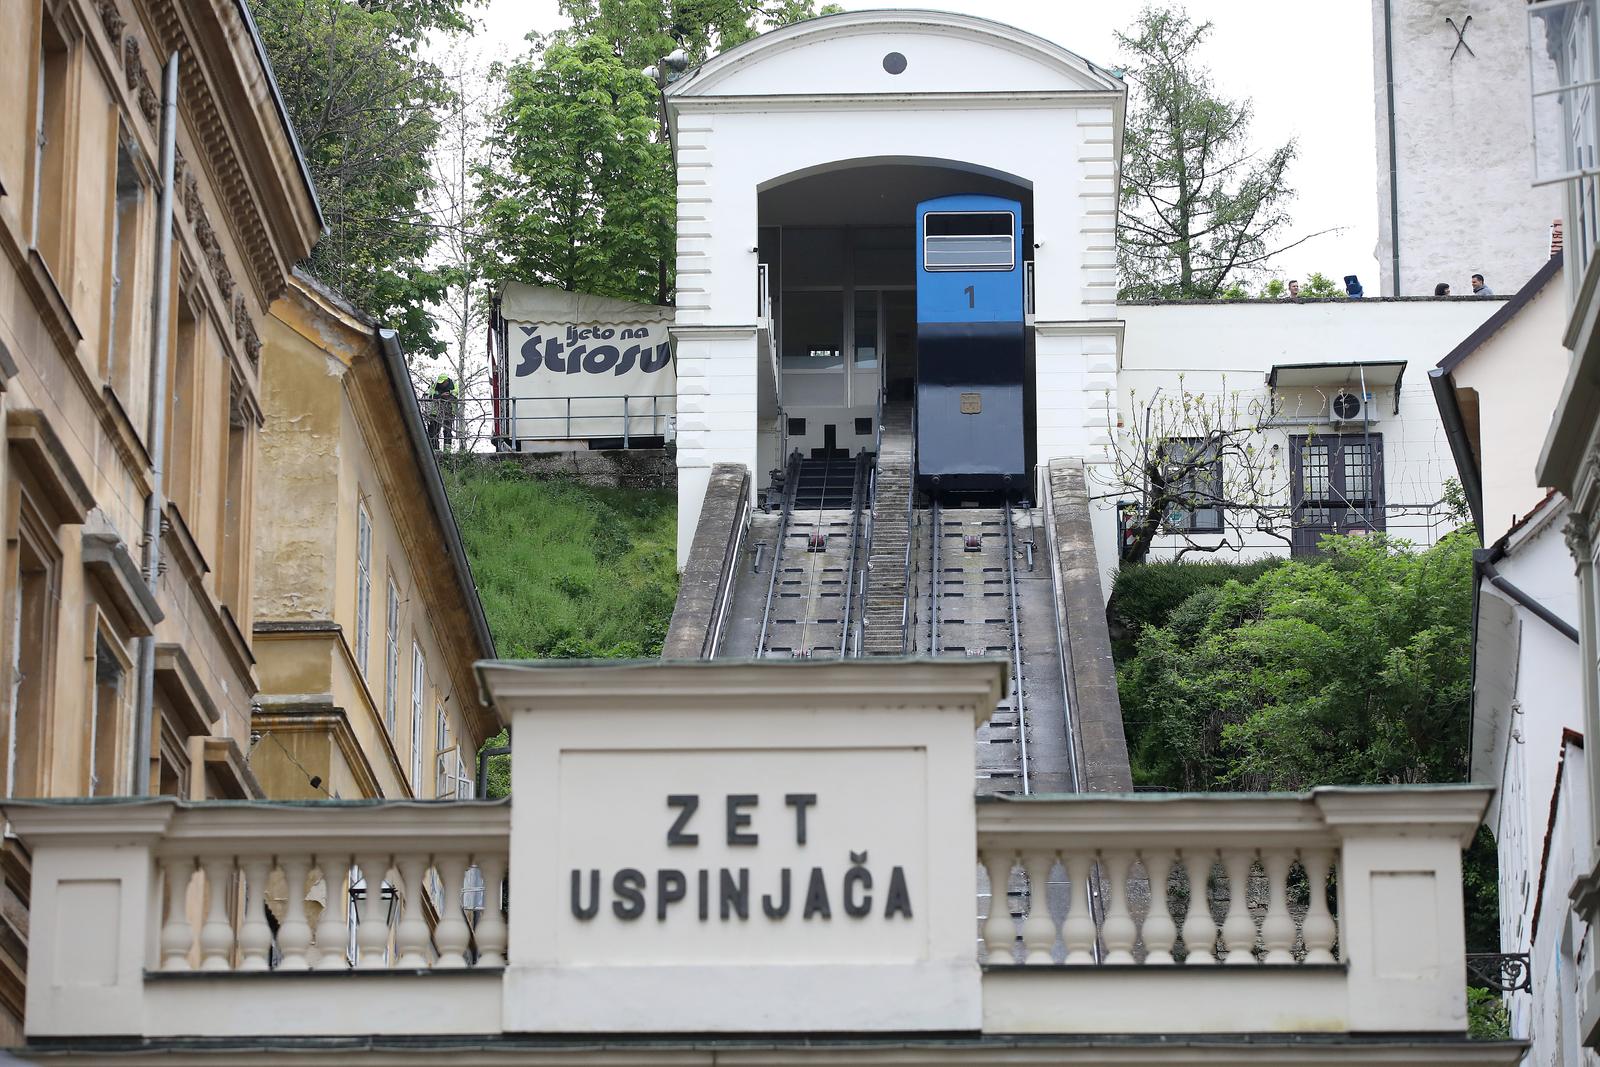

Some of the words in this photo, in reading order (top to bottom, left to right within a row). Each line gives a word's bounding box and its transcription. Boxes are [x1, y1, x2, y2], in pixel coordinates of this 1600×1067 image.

[964, 285, 975, 309] 1
[515, 326, 671, 377] Štrosu
[566, 325, 615, 347] ljeto
[620, 327, 649, 340] na
[667, 794, 817, 847] ZET
[570, 850, 913, 921] USPINJAČA
